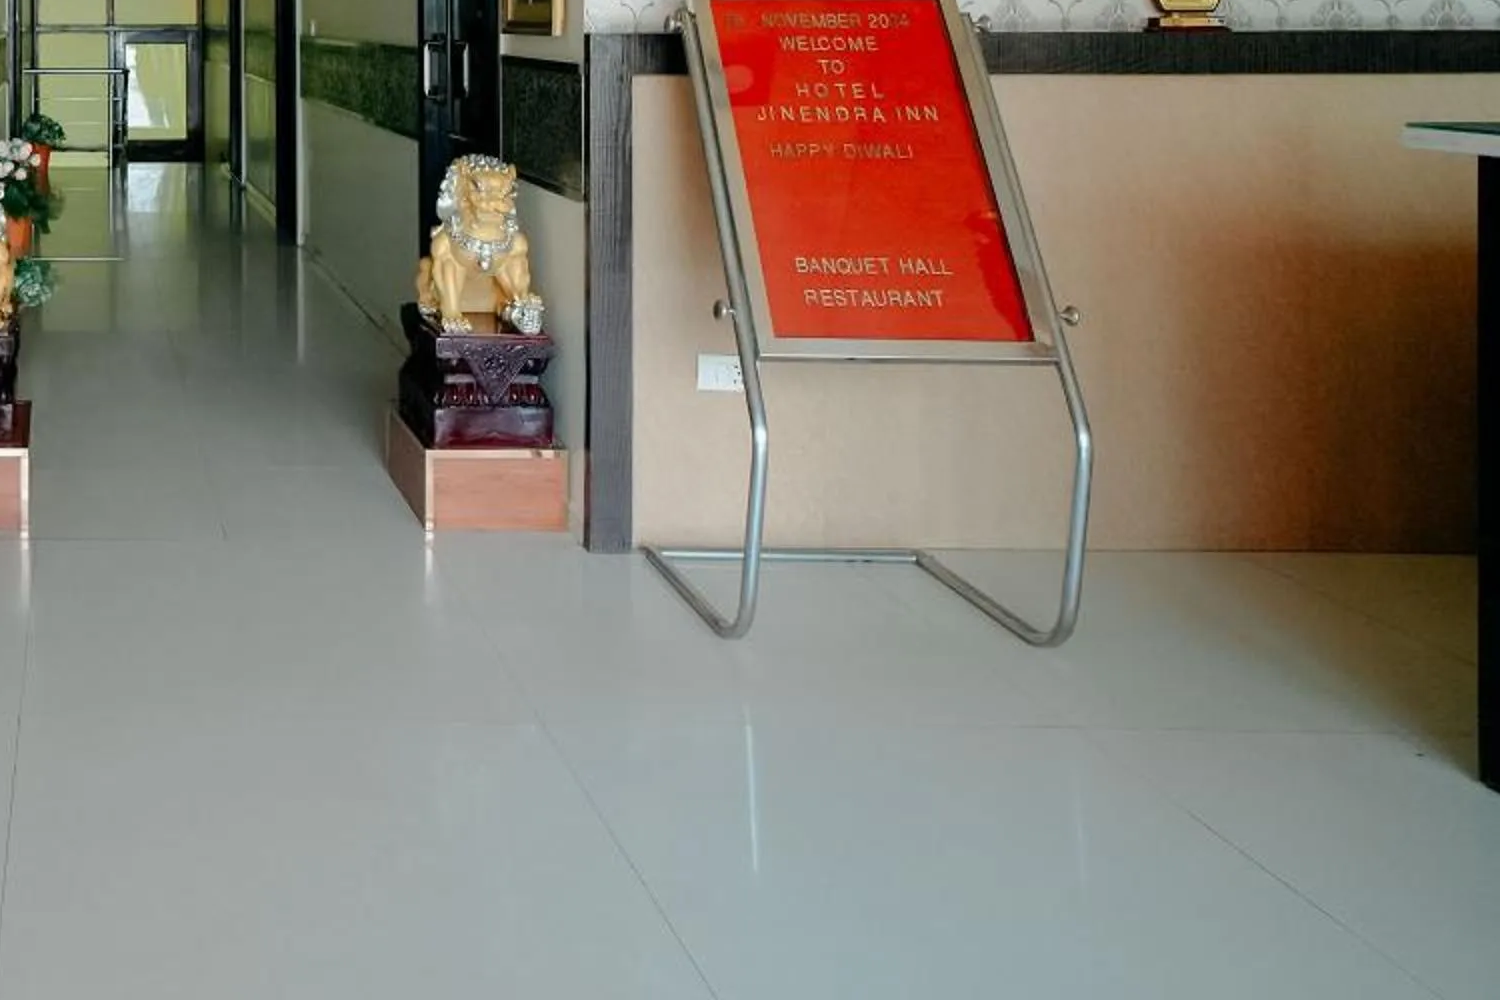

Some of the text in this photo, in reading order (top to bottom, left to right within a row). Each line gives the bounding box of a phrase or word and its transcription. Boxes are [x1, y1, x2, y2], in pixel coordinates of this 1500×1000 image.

[761, 13, 862, 29] NOVEMBER
[780, 36, 879, 51] WELCOME
[817, 59, 845, 75] TO
[795, 83, 885, 99] HOTEL
[757, 105, 939, 123] JINENDRA INN
[770, 143, 914, 159] HAPPY DIWALI
[795, 256, 954, 276] BANQUET HALL
[804, 288, 945, 309] RESTAURANT
